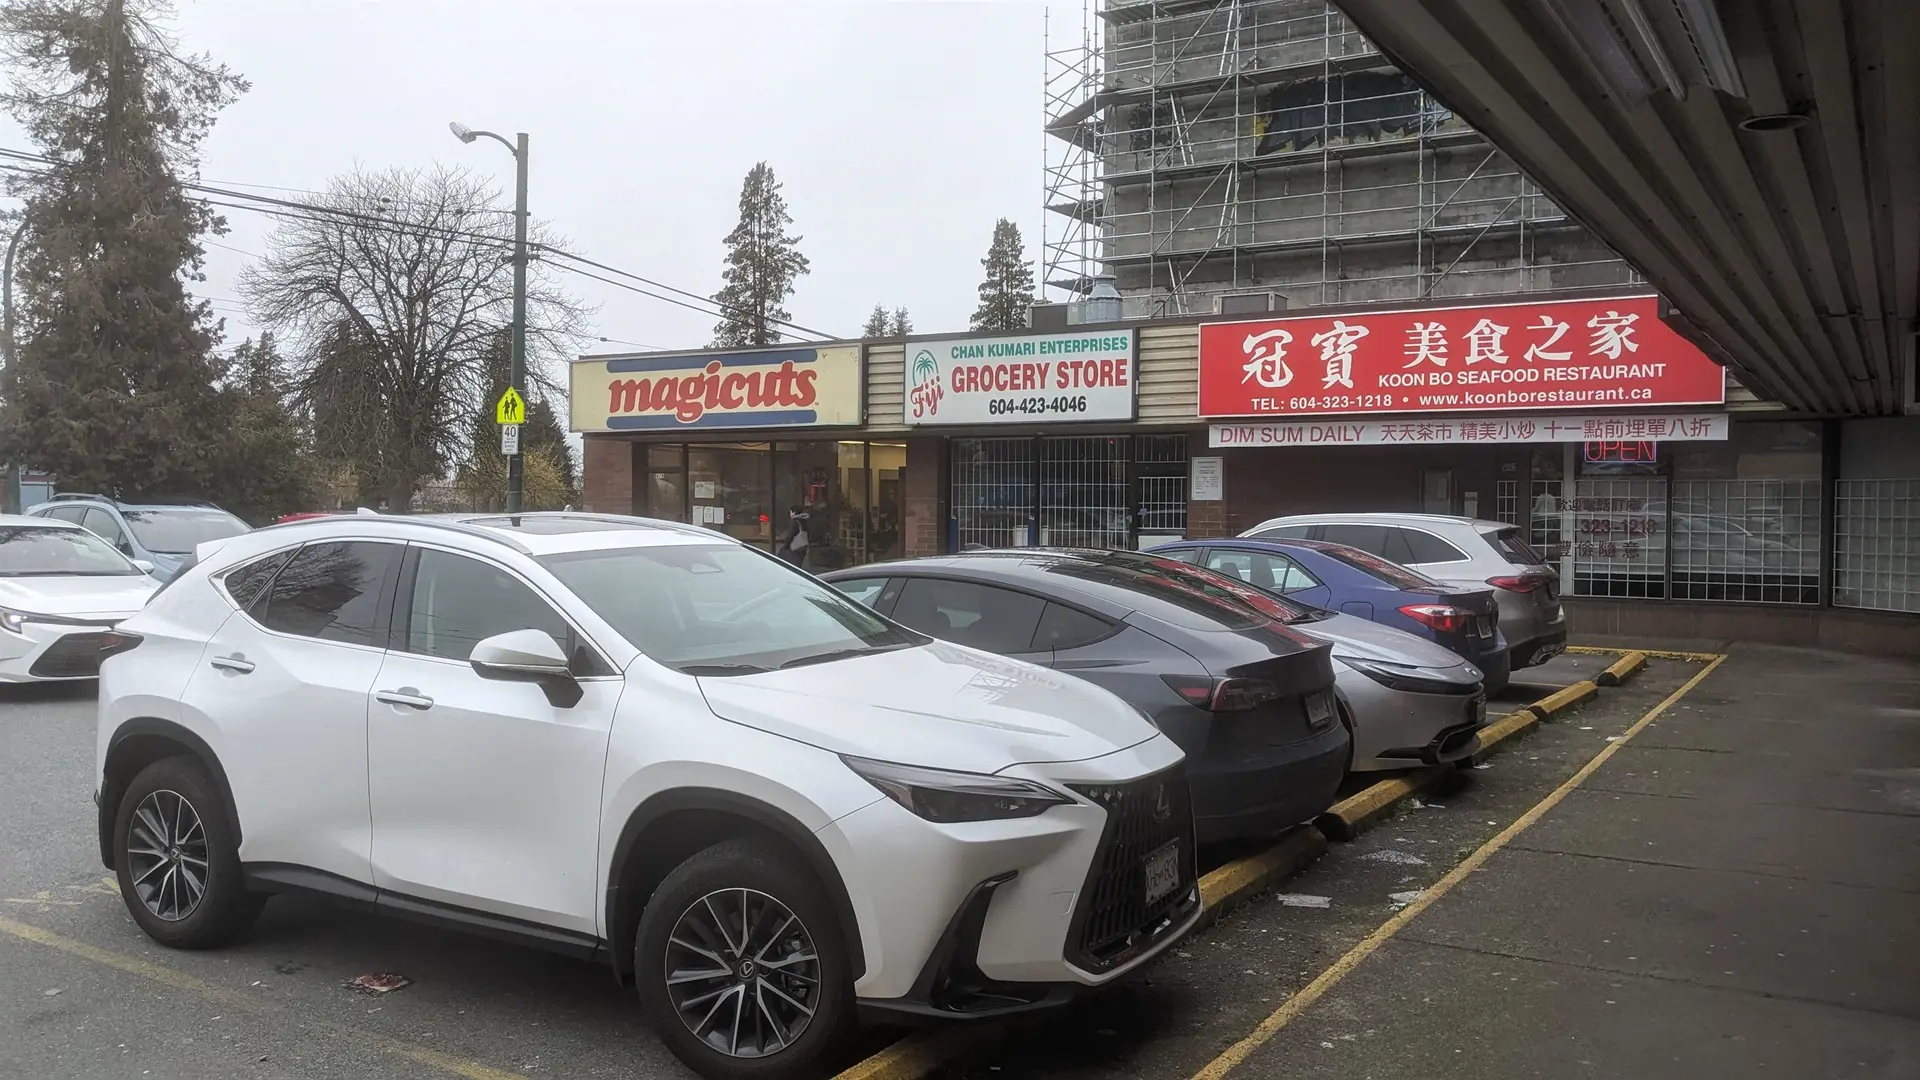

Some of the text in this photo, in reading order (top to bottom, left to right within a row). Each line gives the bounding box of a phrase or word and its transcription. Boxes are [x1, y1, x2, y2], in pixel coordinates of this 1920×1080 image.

[951, 336, 1128, 359] CHAN KUMARI ENTERPRISES
[1402, 309, 1640, 369] 美食之家
[951, 358, 1128, 393] GROCERY STORE
[1379, 363, 1666, 388] KOON BO SEAFOOD RESTAURANT
[608, 361, 818, 423] magicuts
[910, 375, 945, 418] Fiji
[1251, 386, 1652, 411] TEL: 604-323-1218 www.koonborestaurant.ca
[989, 395, 1087, 415] 604-423-4046
[504, 426, 517, 438] 40
[1220, 416, 1712, 443] DIM SUM DAILY 天天茶市 精美小炒 十一點前埋單八折
[1586, 440, 1655, 461] OPEN
